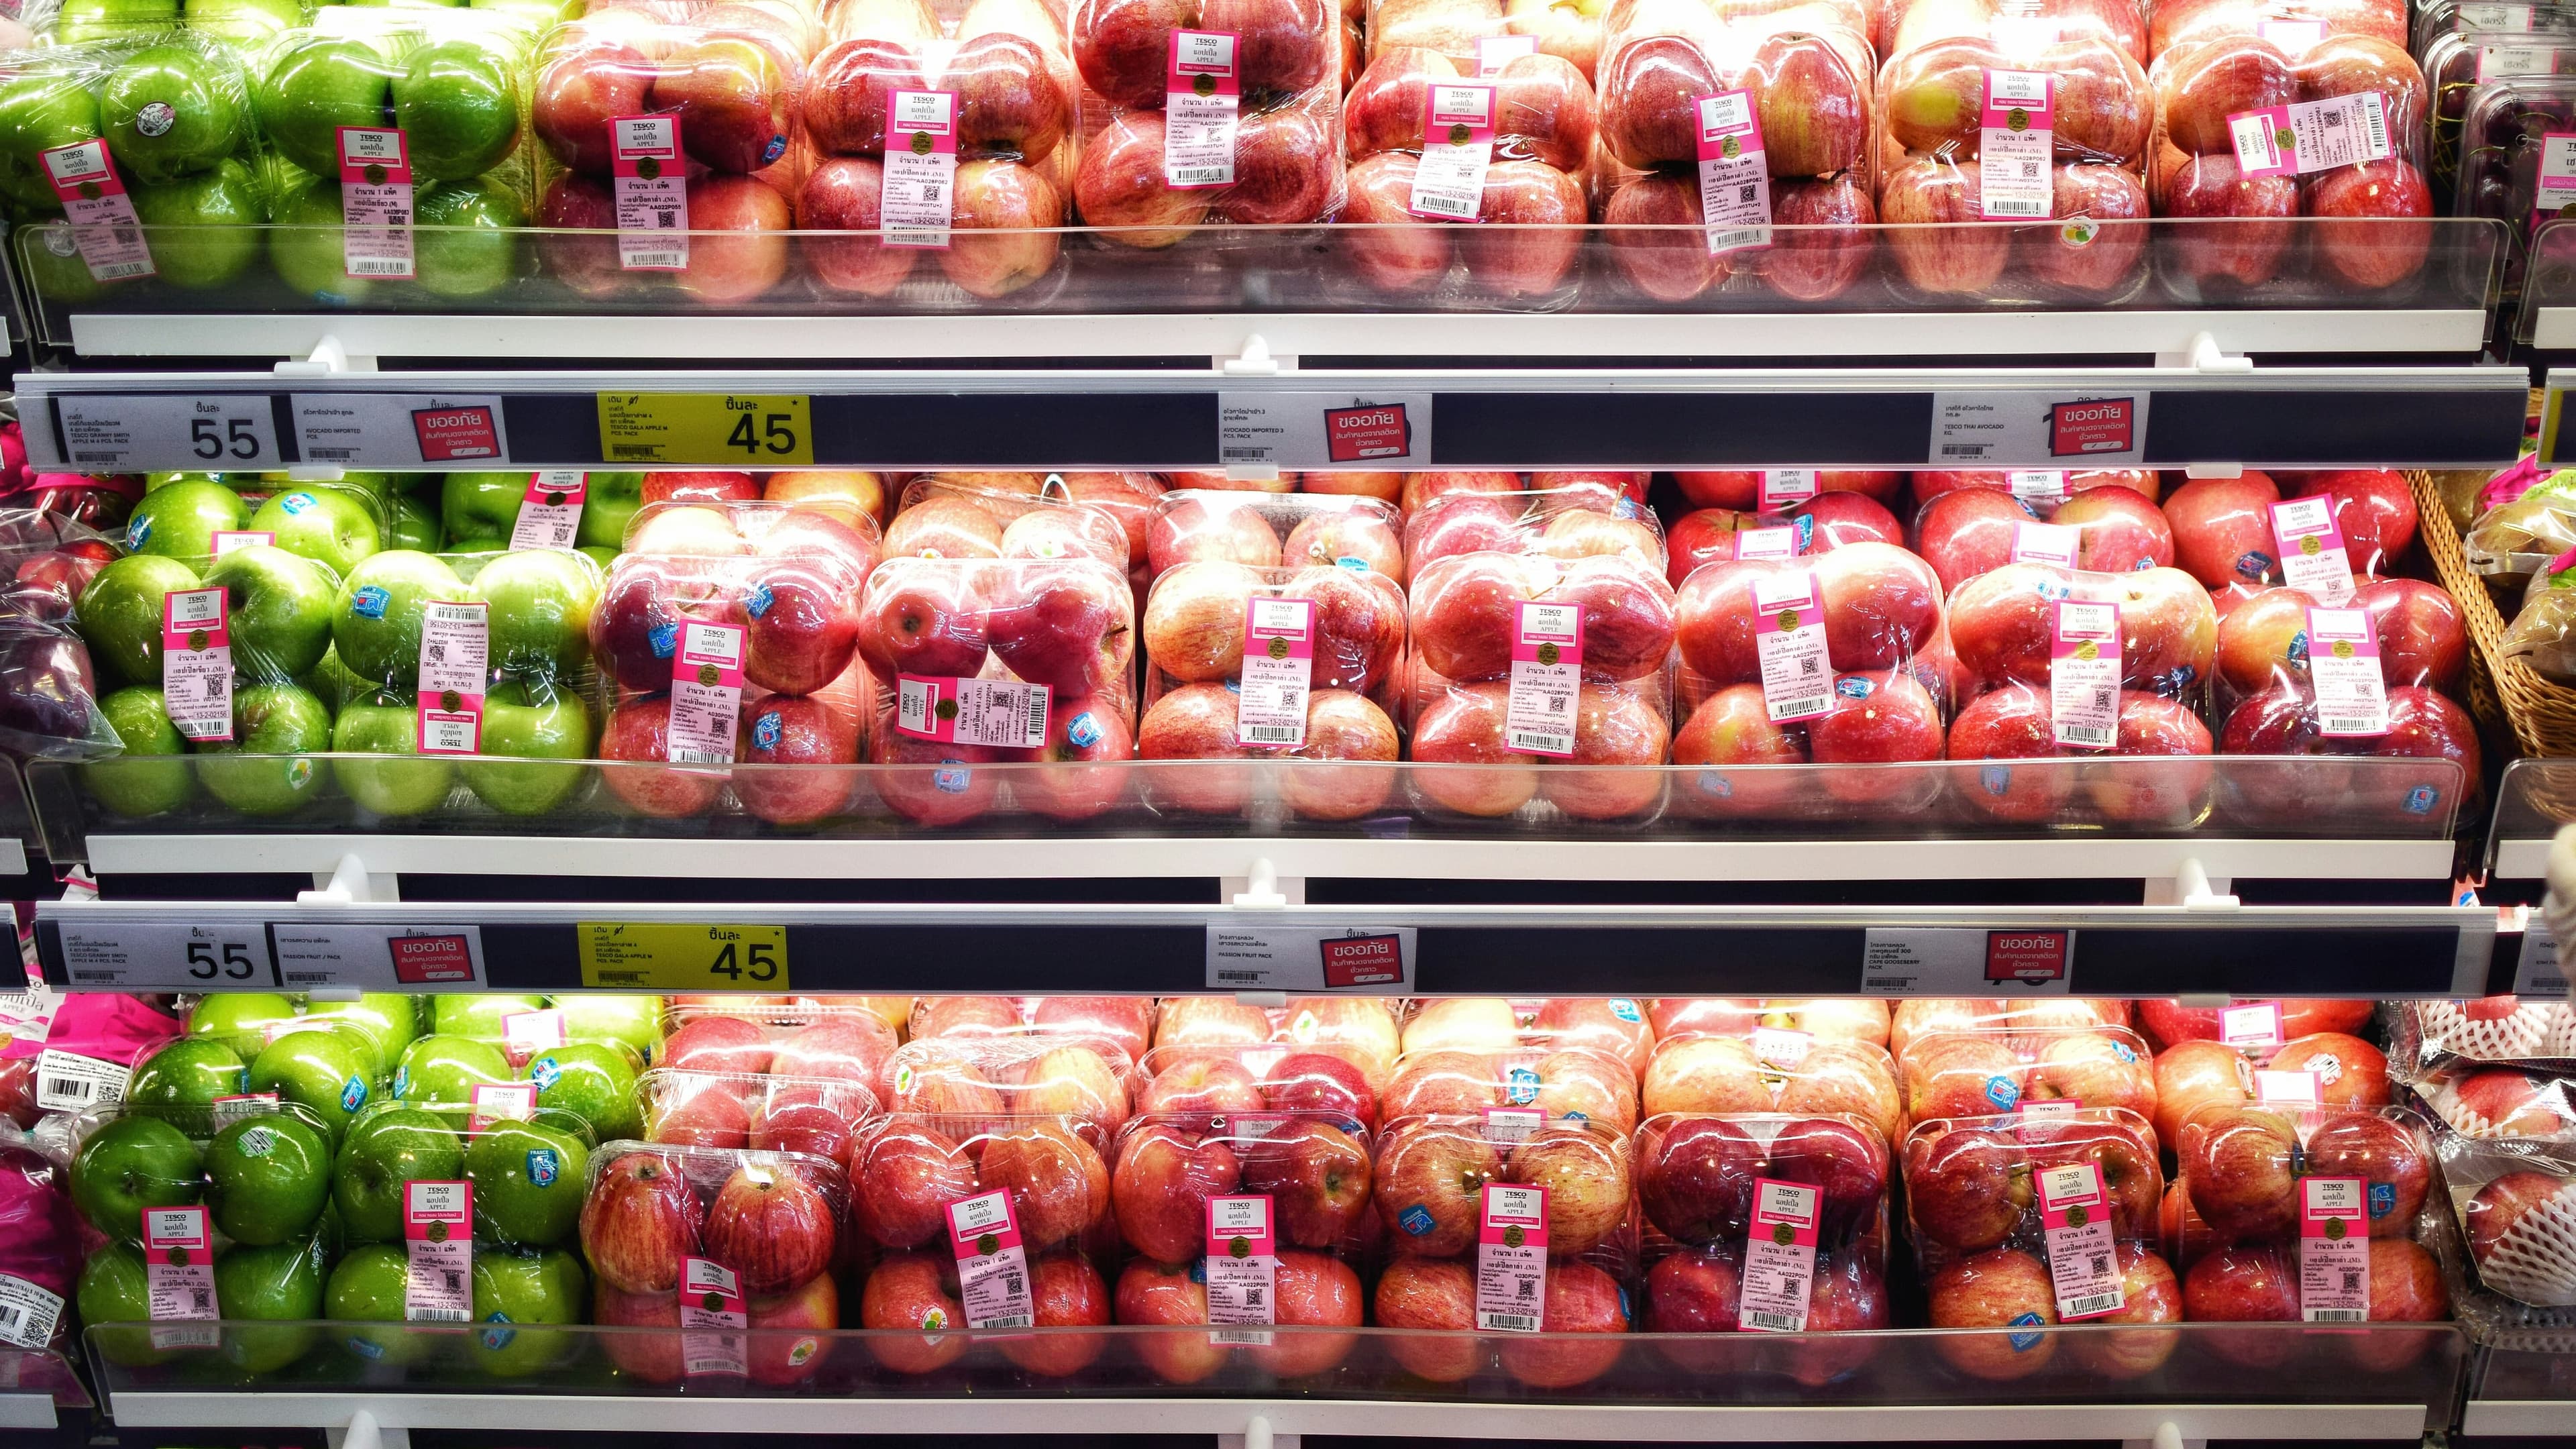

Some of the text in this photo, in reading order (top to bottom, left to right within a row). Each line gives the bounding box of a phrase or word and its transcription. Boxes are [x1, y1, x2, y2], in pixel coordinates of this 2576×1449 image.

[1182, 99, 1202, 107] จำนวน
[61, 150, 84, 158] TESCO
[355, 188, 375, 196] จำนวน
[1445, 191, 1476, 199] 13-2-02156
[197, 402, 220, 413] ชิ้นละ
[726, 396, 757, 410] ชิ้นละ
[2065, 405, 2121, 421] ขออภัย
[427, 413, 481, 428] ขออภัย
[1339, 412, 1394, 428] ขออภัย
[727, 413, 796, 453] 45
[191, 419, 260, 459] 55
[1796, 688, 1828, 698] 13-2-02156
[2085, 720, 2113, 729] 13-2-02156
[1540, 726, 1571, 735] 13-2-02156
[700, 745, 731, 754] 13-2-02156
[709, 927, 740, 940] ชิ้นละ
[403, 940, 456, 952] ขออภัย
[2000, 936, 2055, 949] ขออภัย
[1334, 942, 1389, 956] ขออภัย
[187, 943, 254, 979] 55
[710, 943, 777, 981] 45
[967, 1200, 989, 1209] TESCO
[974, 1218, 991, 1226] APPLE
[704, 1263, 721, 1273] TESCO
[2087, 1285, 2118, 1294] 13-2-02156
[998, 1308, 1028, 1316] 13-2-02156
